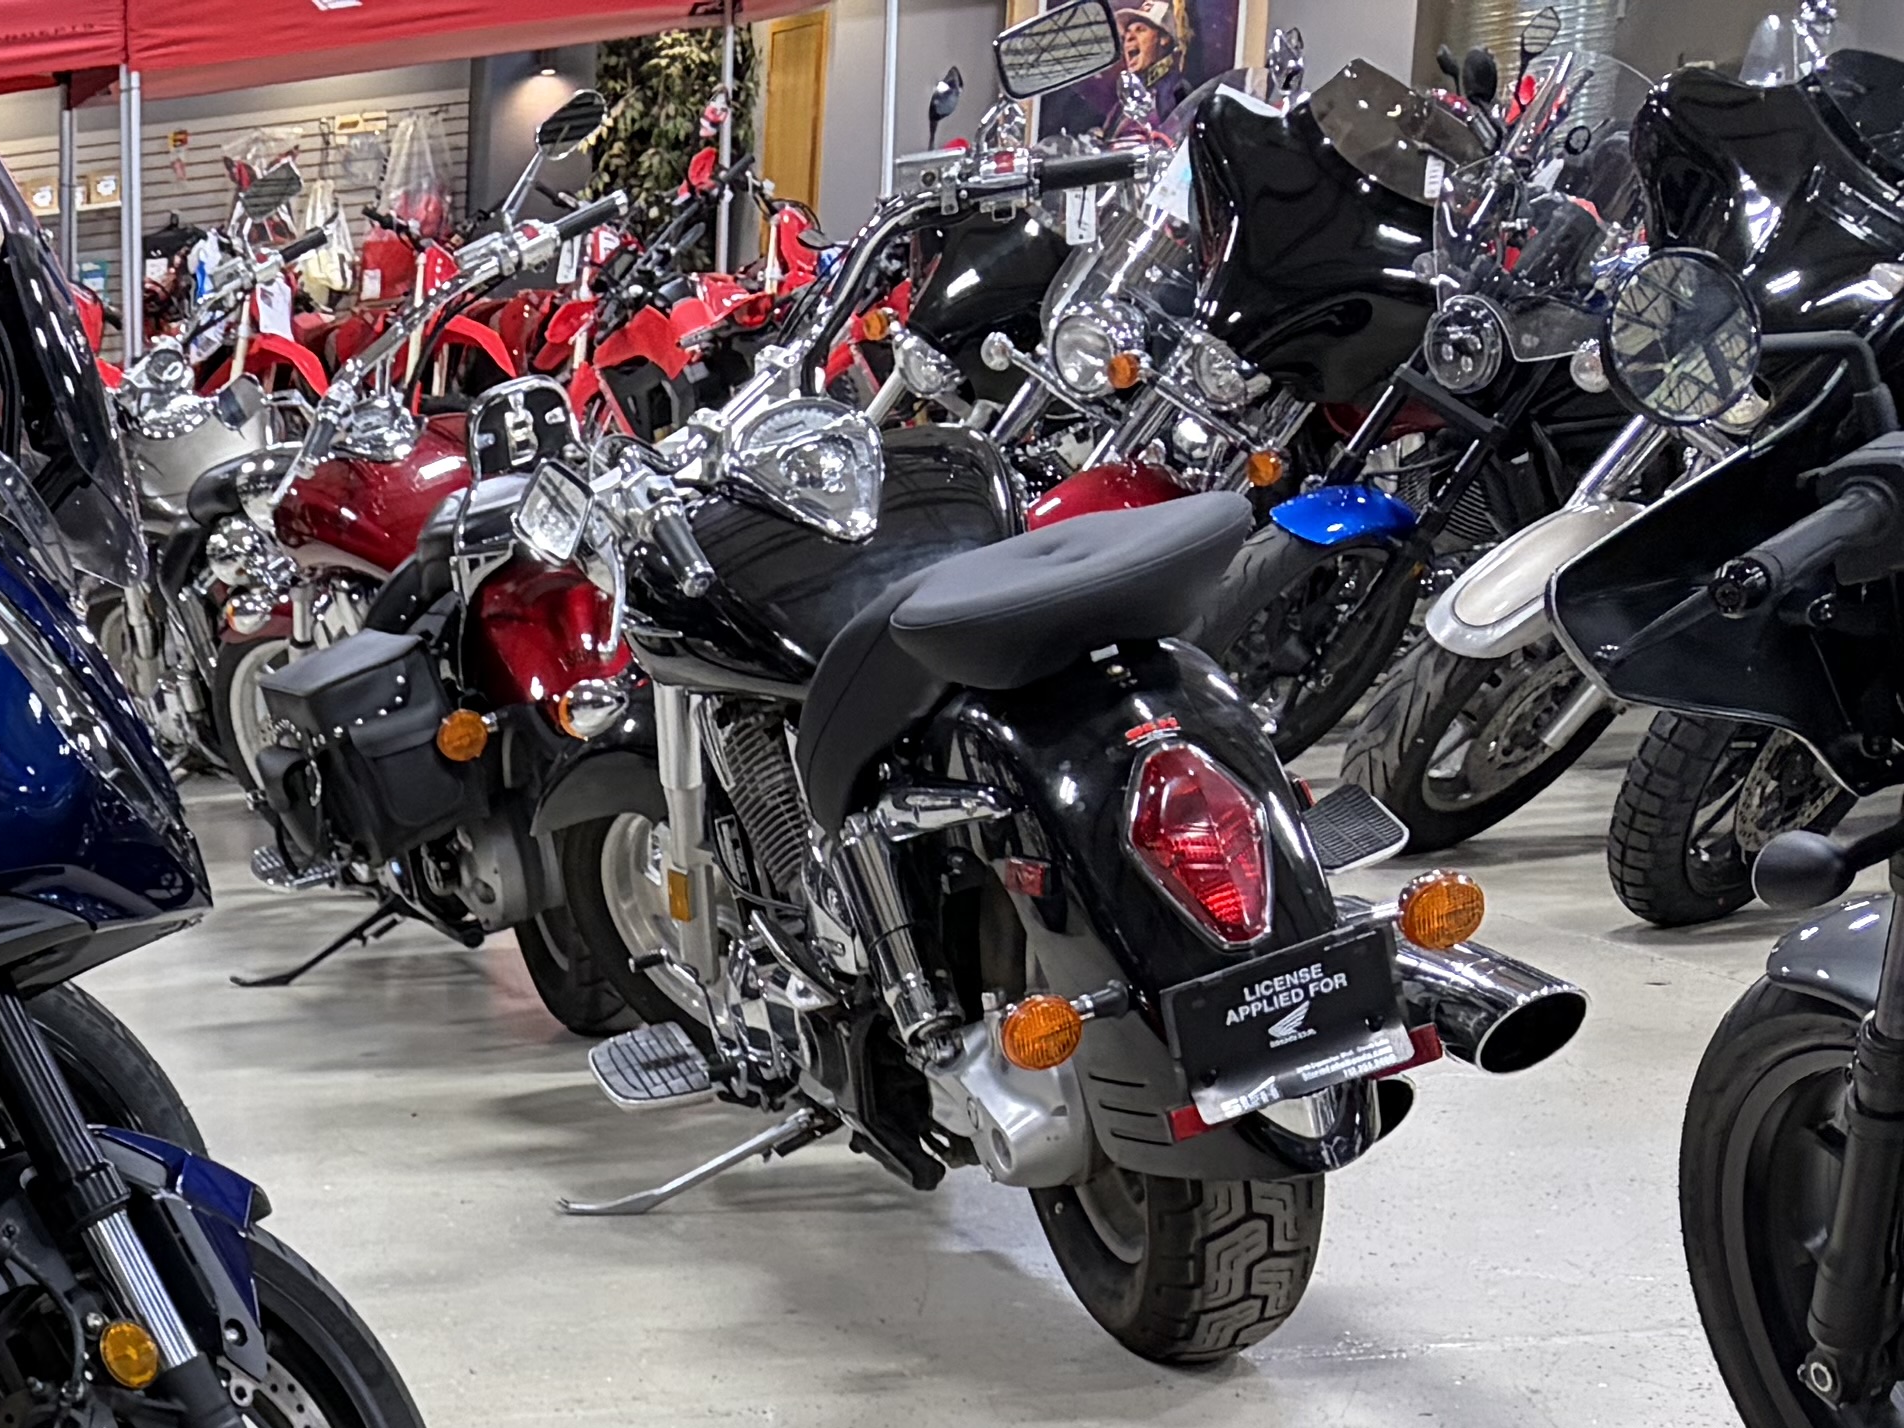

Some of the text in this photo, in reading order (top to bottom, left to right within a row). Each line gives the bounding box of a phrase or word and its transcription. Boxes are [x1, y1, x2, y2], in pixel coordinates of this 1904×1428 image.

[1226, 973, 1348, 1026] APPLIED FOR
[1243, 963, 1324, 1002] LICENSE
